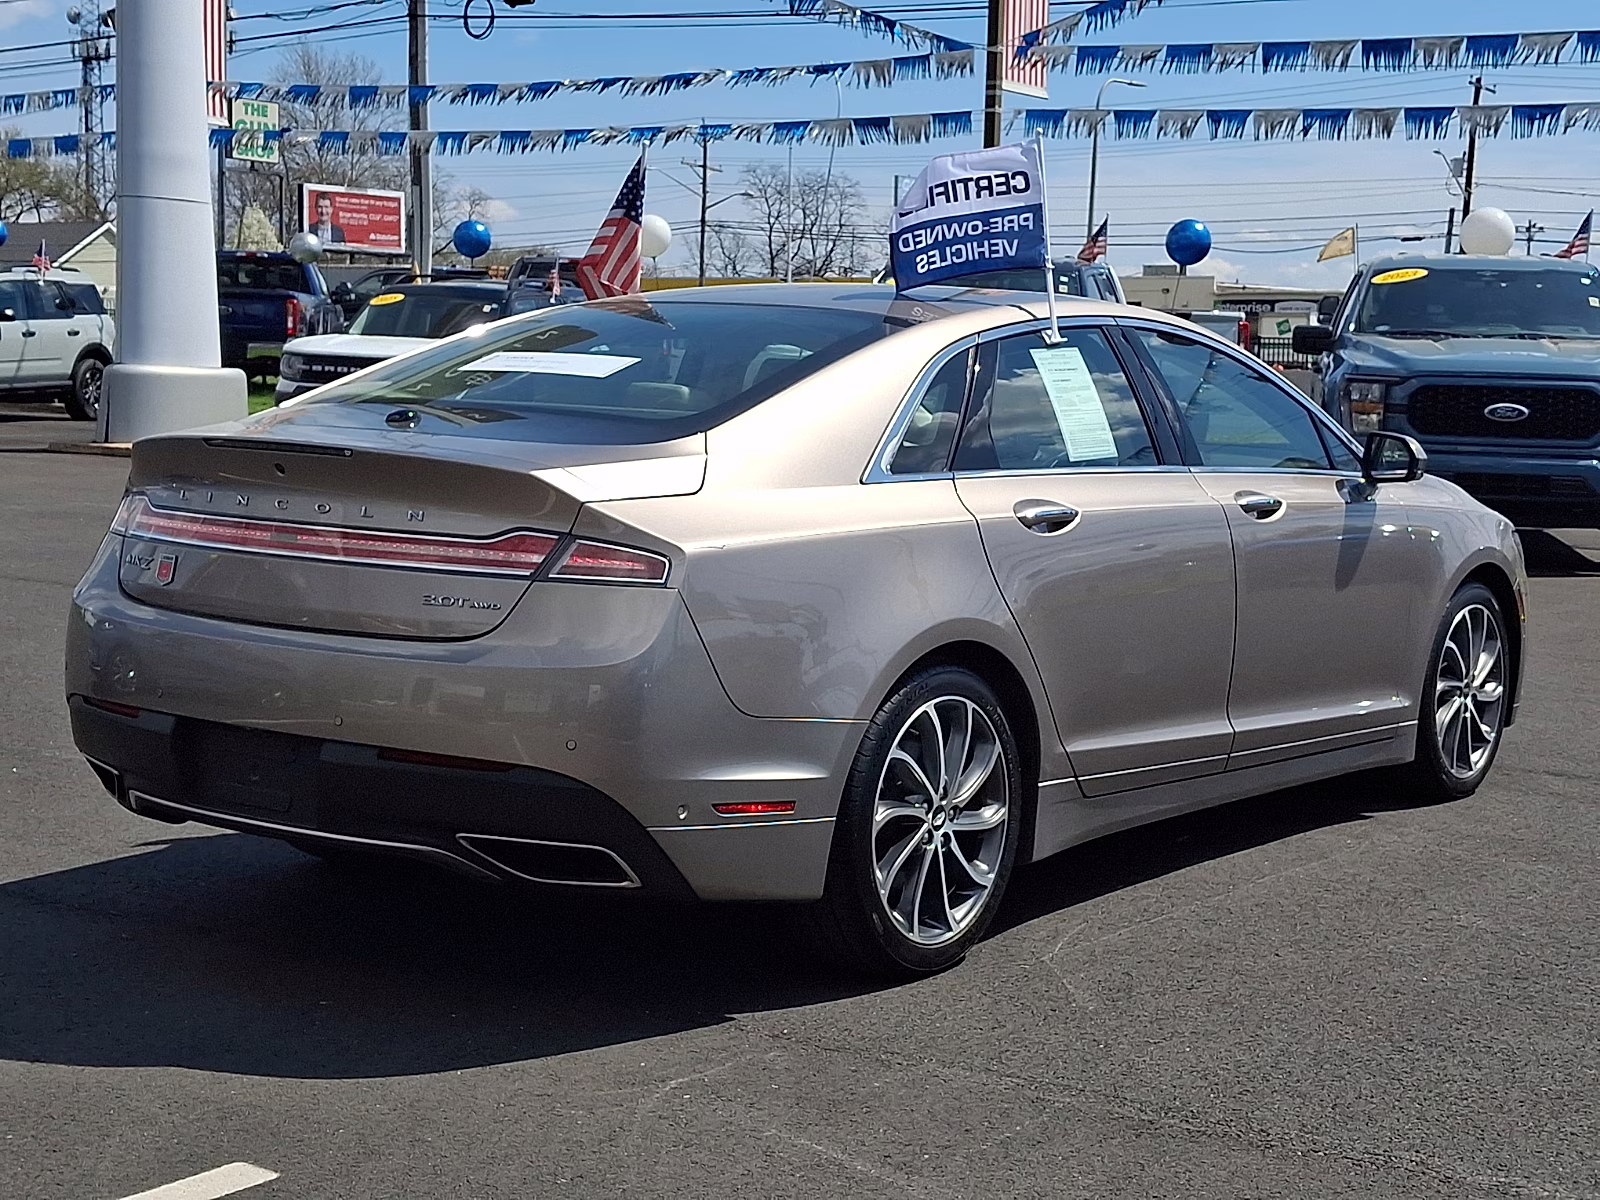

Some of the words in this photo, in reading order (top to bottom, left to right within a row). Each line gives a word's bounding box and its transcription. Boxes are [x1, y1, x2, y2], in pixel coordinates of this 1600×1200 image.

[243, 102, 269, 118] THE
[237, 144, 275, 159] SHOP
[1495, 407, 1519, 418] Ford
[179, 488, 426, 523] LINCOLN
[470, 601, 502, 611] AWD
